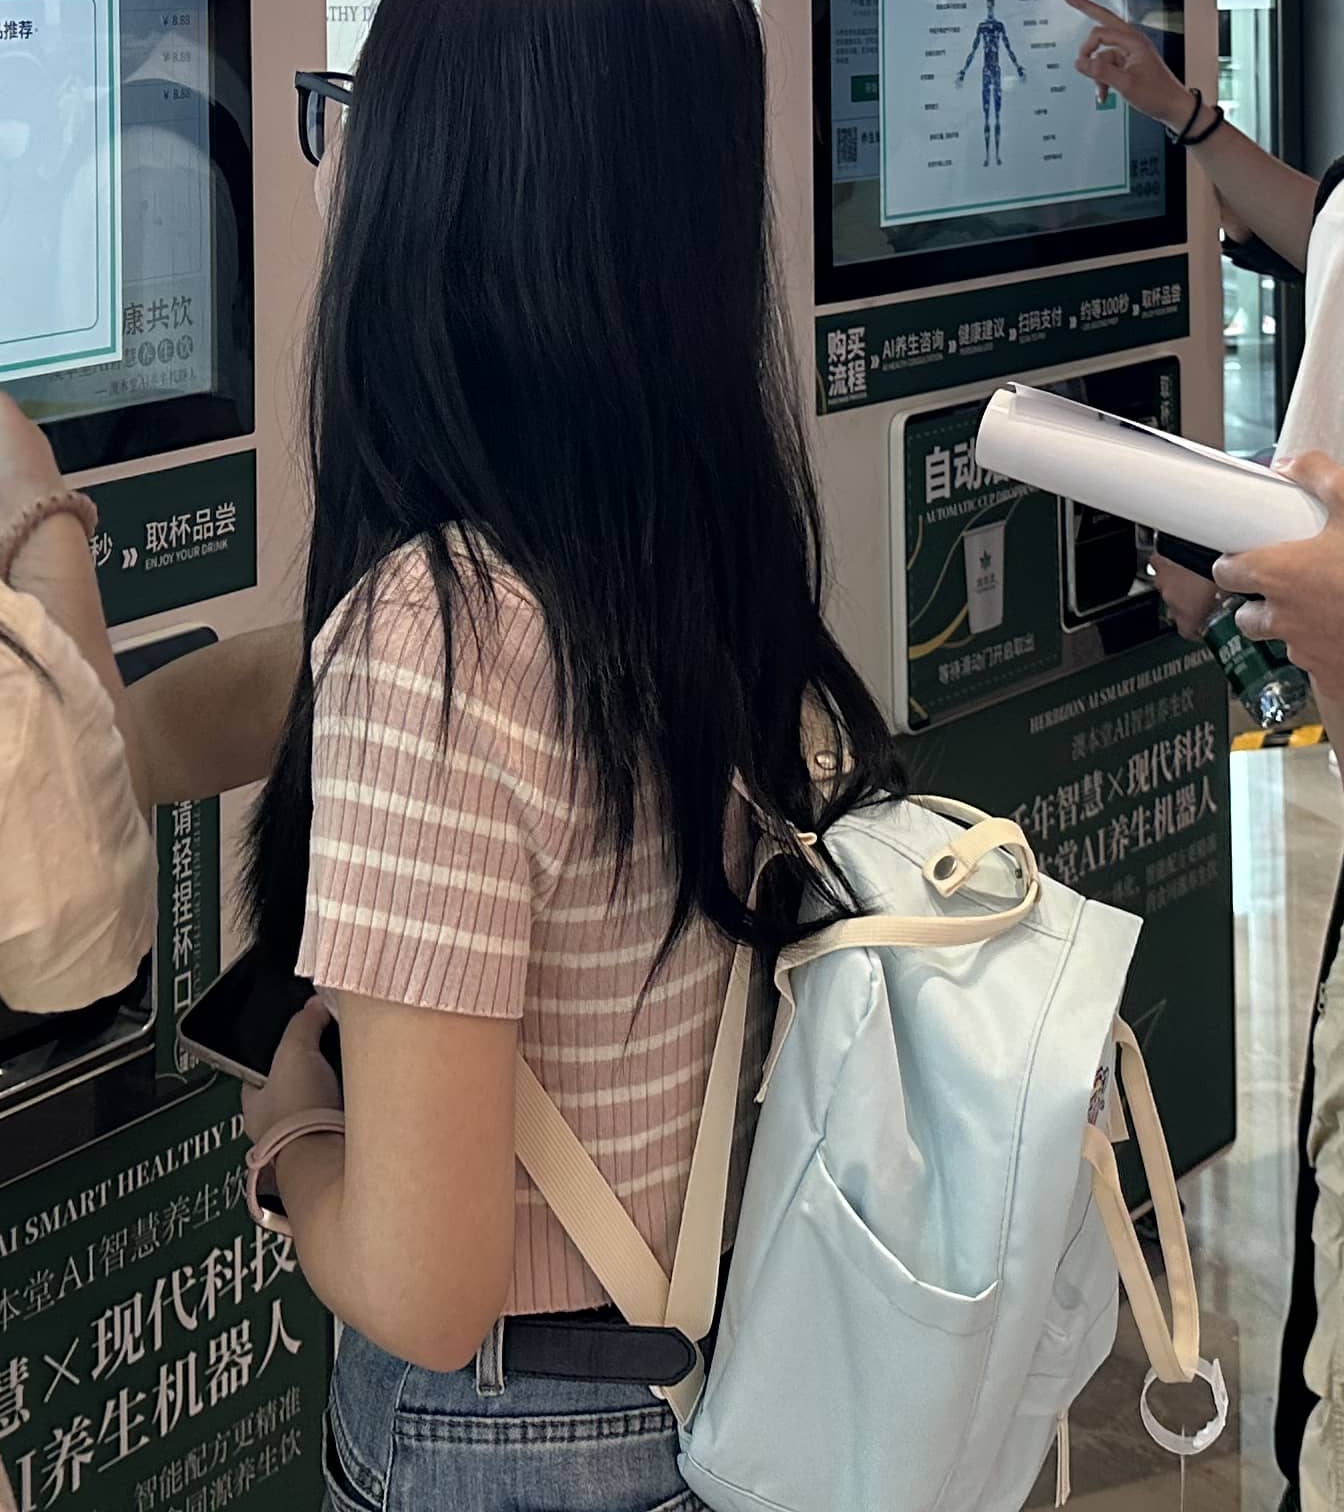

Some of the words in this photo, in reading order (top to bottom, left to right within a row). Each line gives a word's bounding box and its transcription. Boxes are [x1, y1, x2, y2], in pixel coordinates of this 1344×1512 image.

[123, 295, 193, 336] 康共饮
[958, 317, 1005, 346] 健康建议
[1018, 305, 1063, 334] 扫码支付
[827, 326, 866, 363] 购买
[882, 328, 945, 360] AI养生咨询
[828, 359, 867, 397] 流程
[144, 501, 237, 553] 取杯品尝
[91, 531, 113, 567] 秒
[144, 550, 175, 572] ENJOY
[175, 545, 201, 564] YOUR
[201, 539, 229, 558] DRINK
[172, 799, 193, 1015] 请轻捏杯口
[24, 1178, 113, 1246] SMART
[117, 1121, 227, 1199] HEALTHY
[133, 1386, 303, 1512] 智能配方更精准
